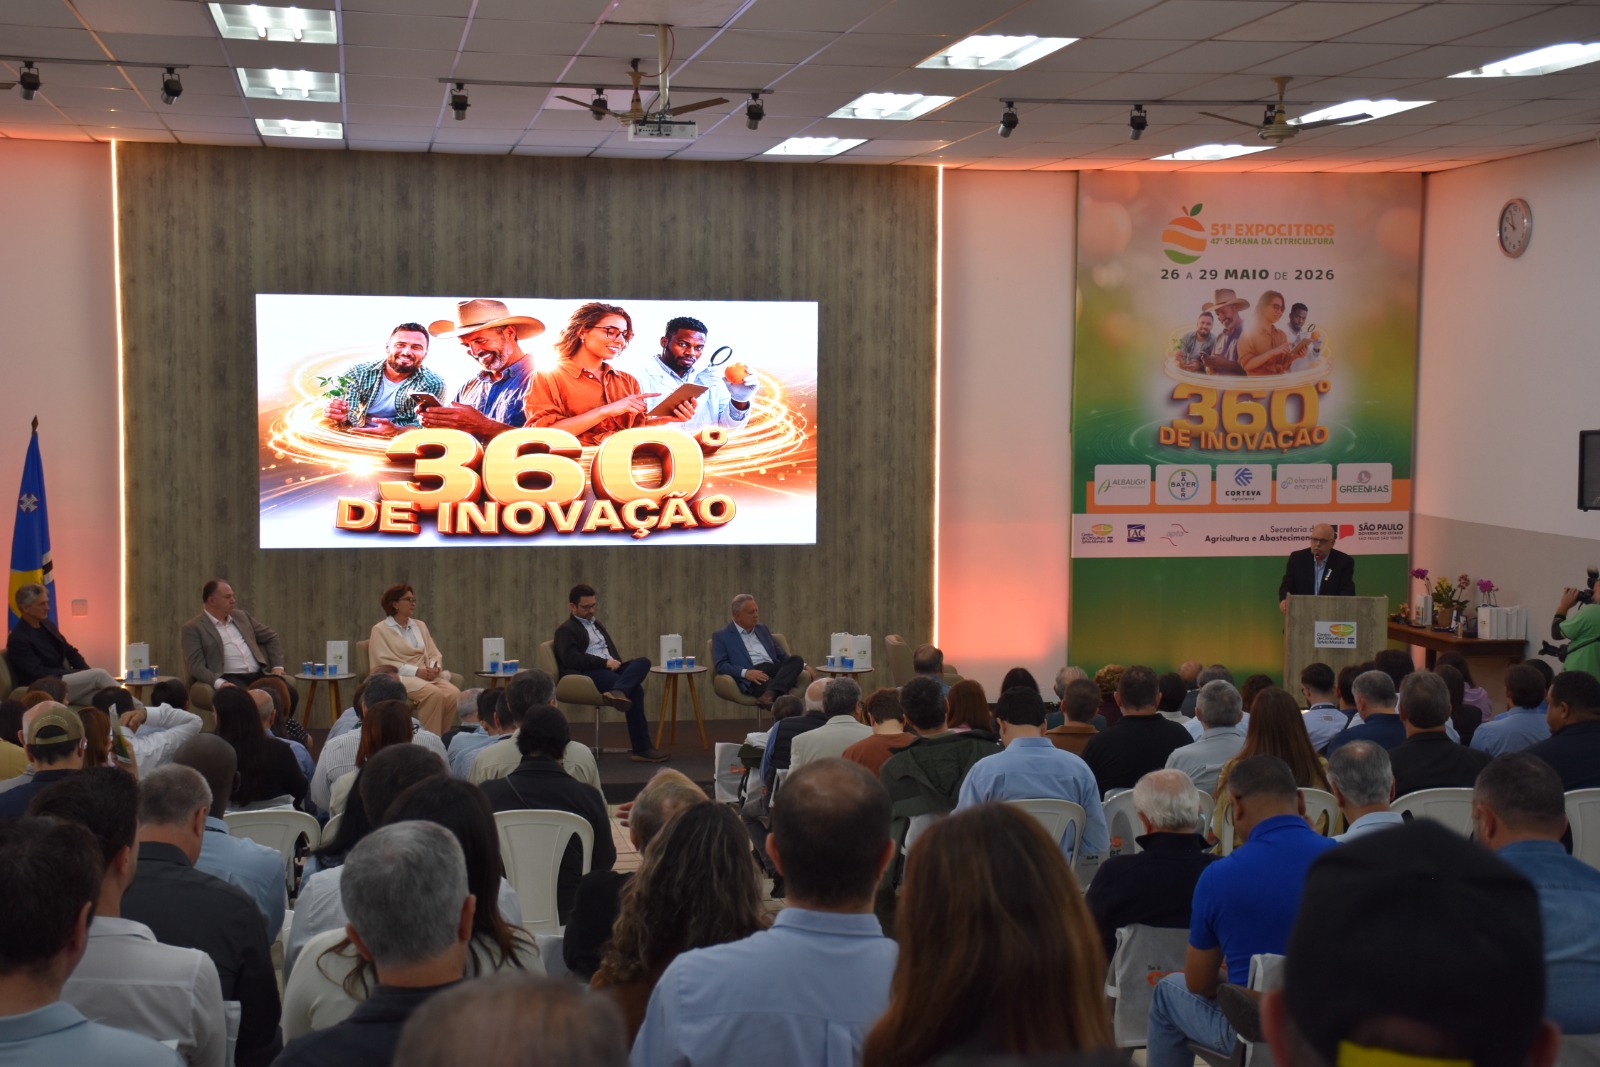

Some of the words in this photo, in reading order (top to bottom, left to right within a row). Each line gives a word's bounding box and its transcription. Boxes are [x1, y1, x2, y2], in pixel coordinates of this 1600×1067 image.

[1235, 223, 1335, 236] EXPOCITROS
[1225, 237, 1259, 245] SEMANA
[1261, 237, 1272, 245] DA
[1274, 237, 1335, 245] CITRICULTURA
[1160, 269, 1180, 280] 26
[1186, 272, 1193, 280] A
[1199, 269, 1218, 280] 29
[1224, 269, 1270, 280] MAIO
[1274, 272, 1288, 280] DE
[1294, 269, 1335, 280] 2026
[1159, 425, 1192, 448] DE
[1339, 485, 1390, 493] GREENHAS
[336, 496, 421, 534] DE
[437, 490, 737, 539] INOVAÇÃO
[1270, 525, 1307, 533] Secretaria
[1358, 523, 1375, 531] SÃO
[1377, 523, 1404, 531] PAULO
[1127, 529, 1145, 537] IAC
[1205, 535, 1249, 543] Agricultura
